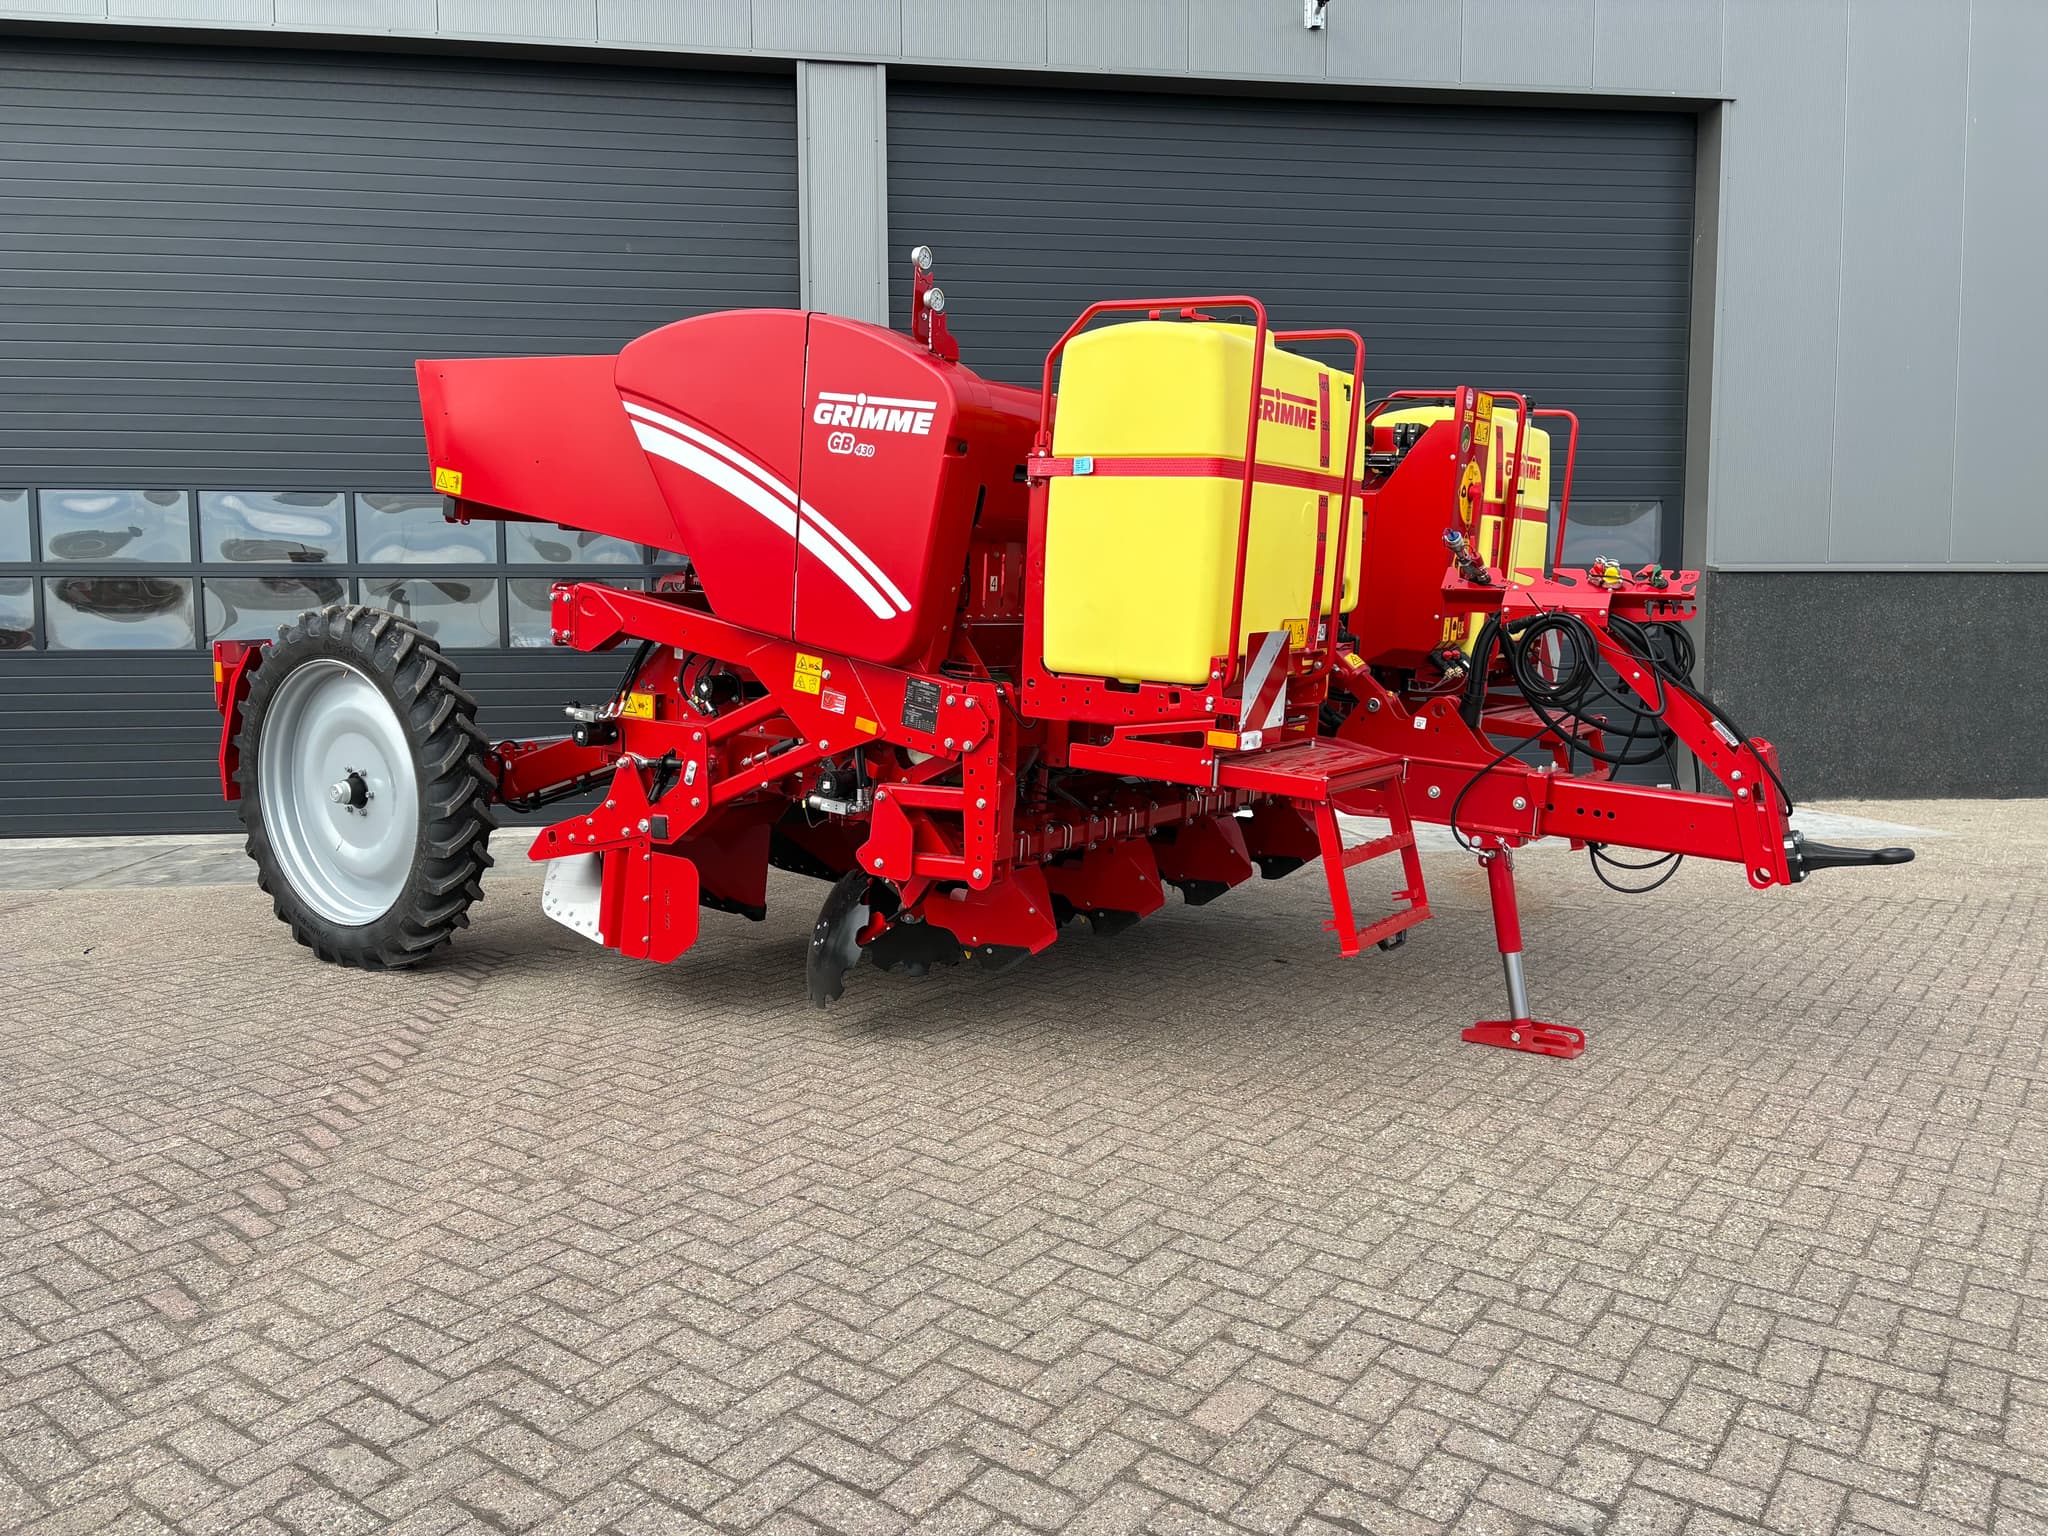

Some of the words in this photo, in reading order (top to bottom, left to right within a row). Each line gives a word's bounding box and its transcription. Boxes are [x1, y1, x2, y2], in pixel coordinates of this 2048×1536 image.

[813, 392, 937, 435] GRIMME
[1259, 388, 1318, 430] RIMME
[829, 433, 854, 453] GB
[855, 444, 874, 456] 430
